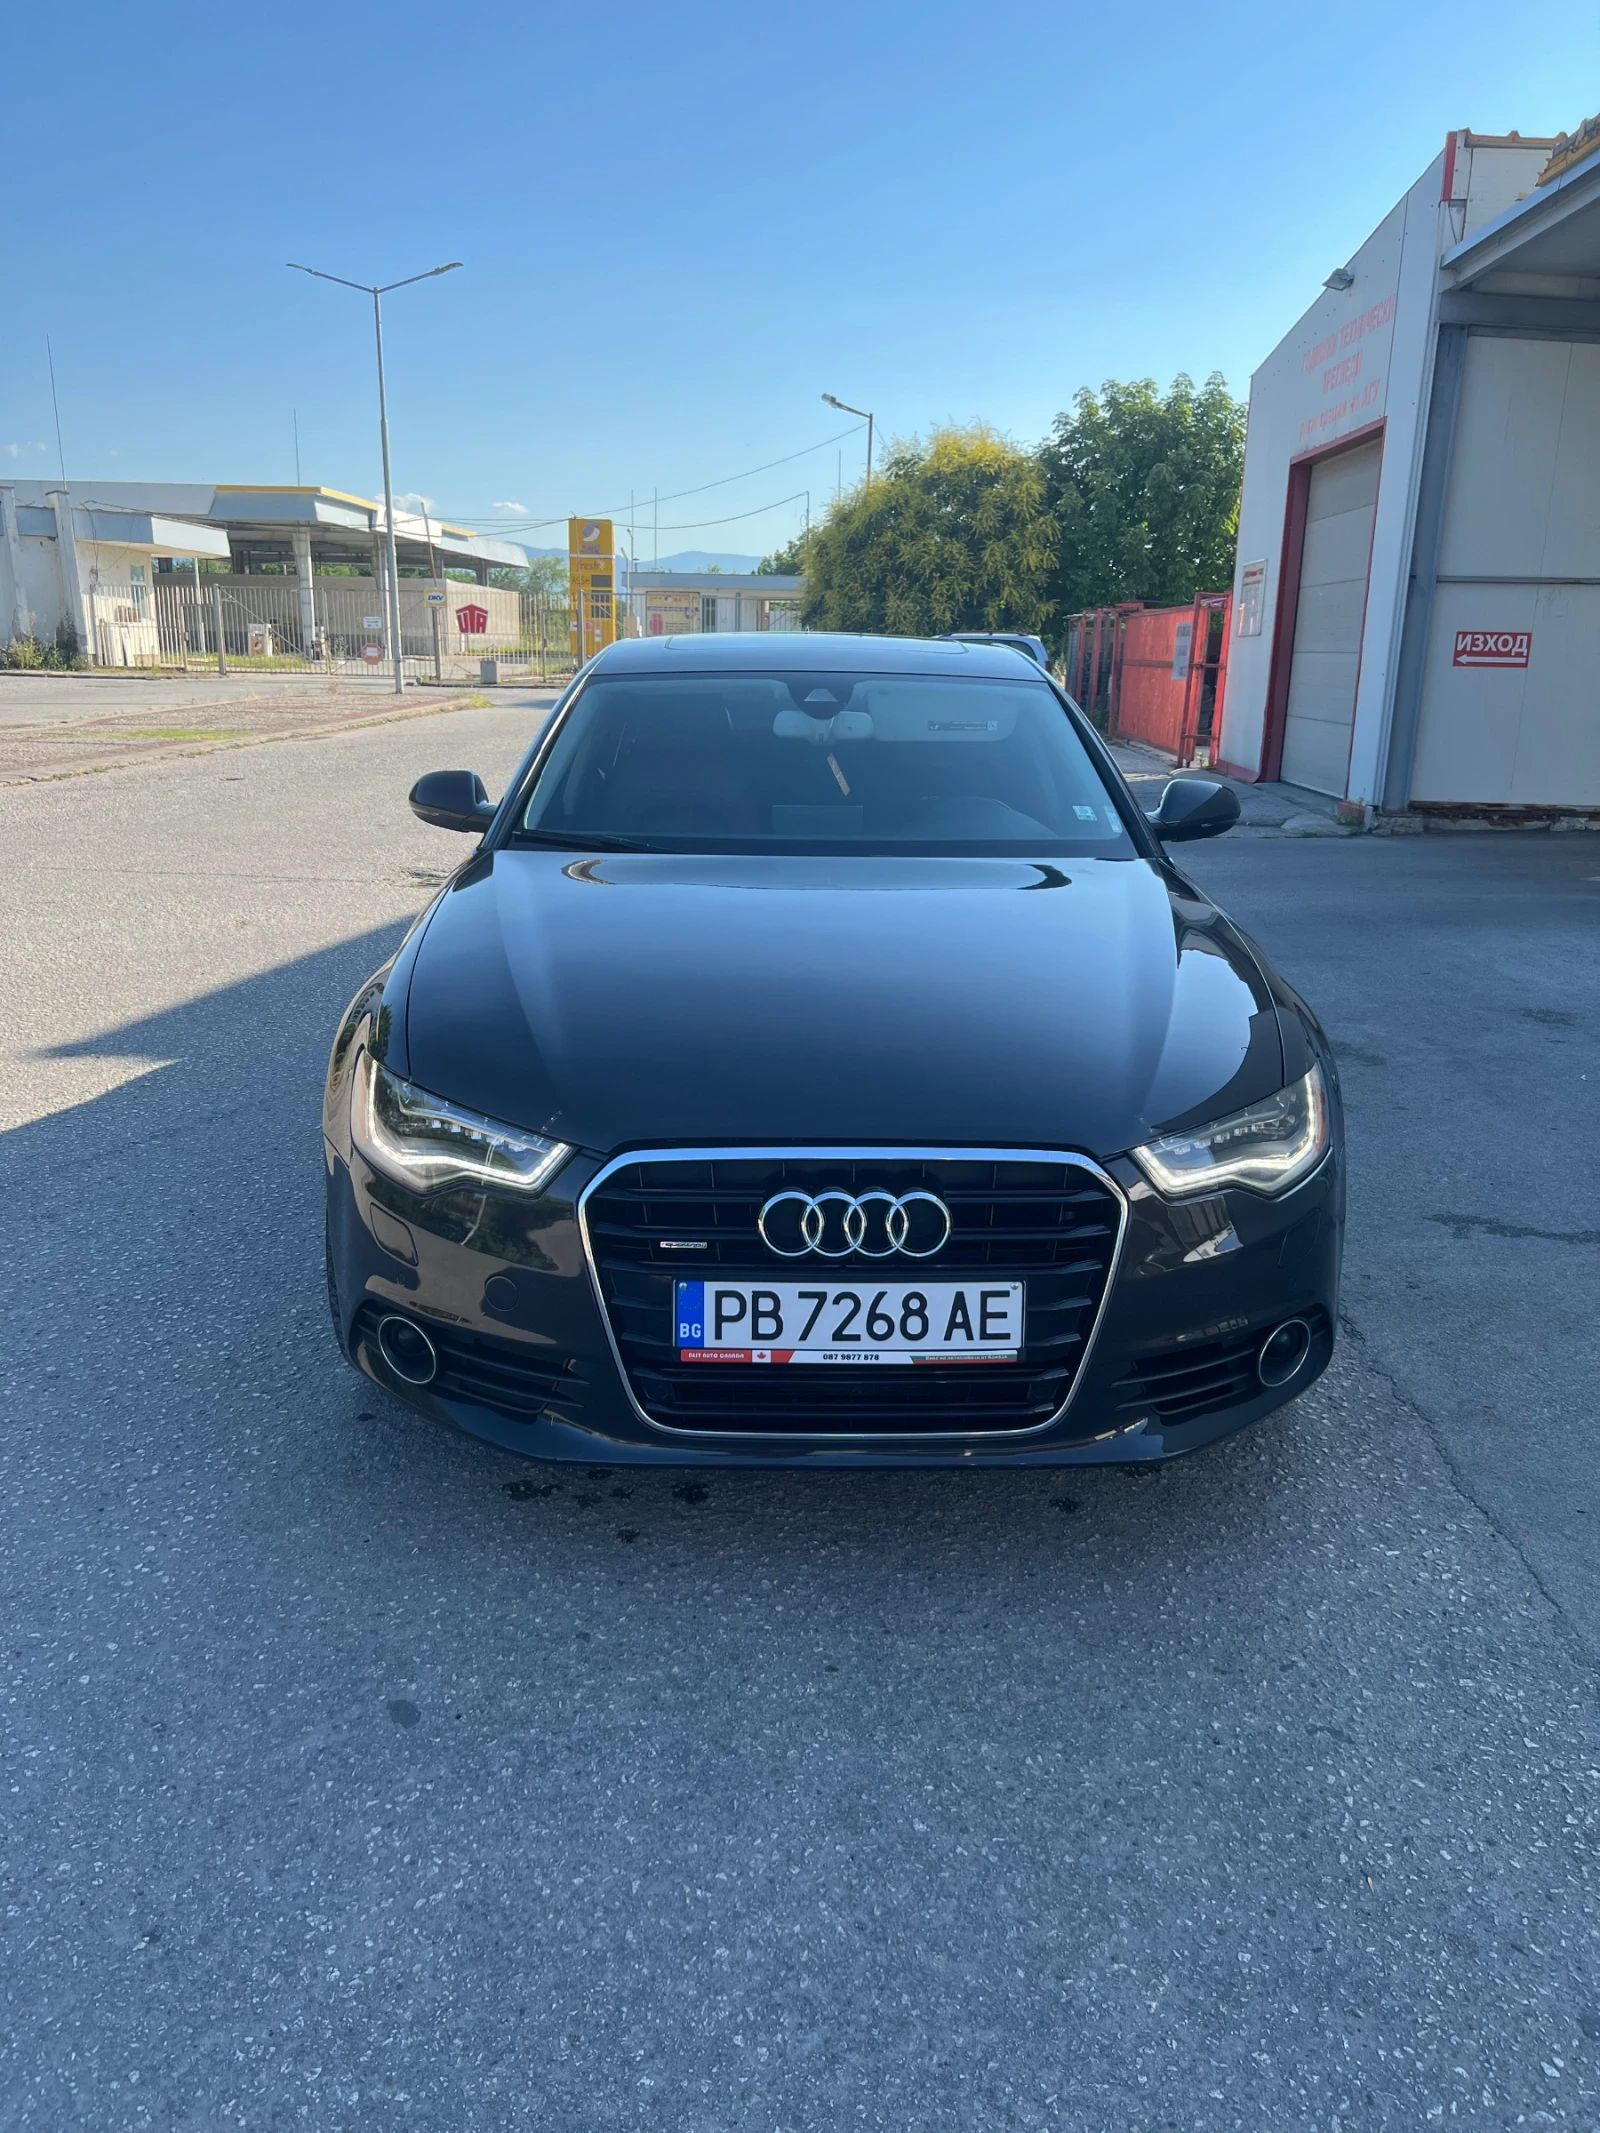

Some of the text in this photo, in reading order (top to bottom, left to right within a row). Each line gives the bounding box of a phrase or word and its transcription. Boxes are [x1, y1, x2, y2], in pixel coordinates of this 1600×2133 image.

[456, 605, 488, 634] UTA
[1456, 634, 1528, 656] ИЗХОД
[714, 1290, 1011, 1342] PB 7268 AE
[679, 1322, 702, 1338] BG
[840, 1353, 862, 1361] 9877
[863, 1353, 880, 1361] 878
